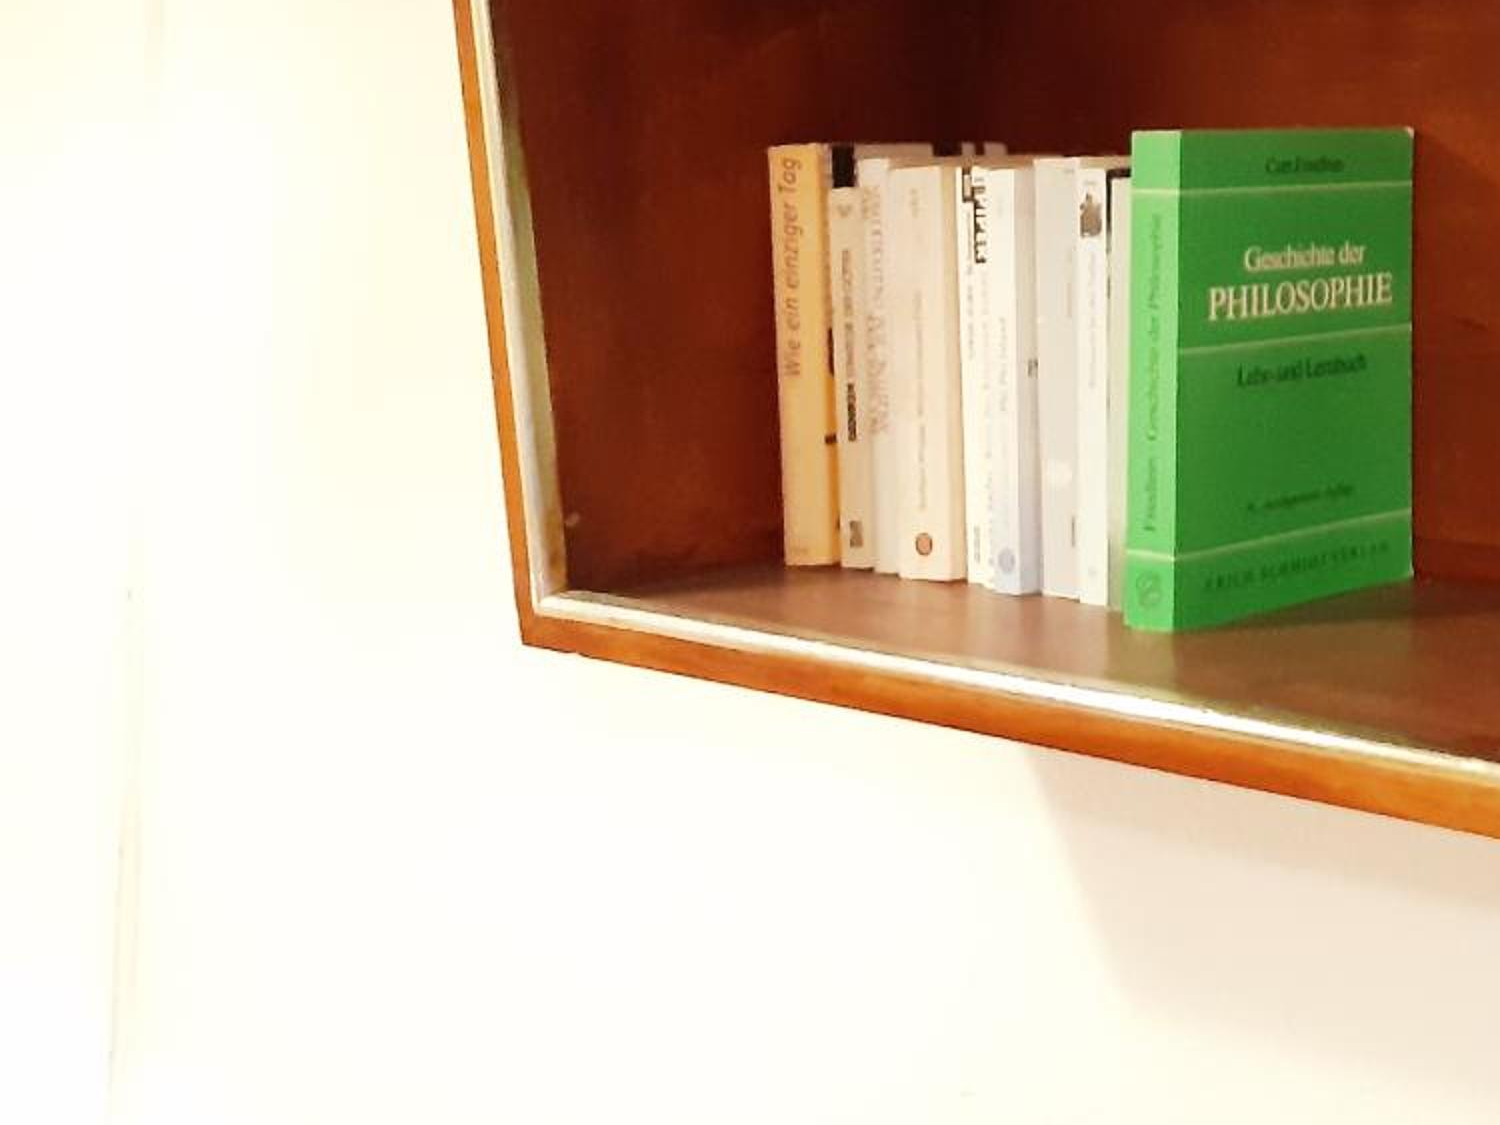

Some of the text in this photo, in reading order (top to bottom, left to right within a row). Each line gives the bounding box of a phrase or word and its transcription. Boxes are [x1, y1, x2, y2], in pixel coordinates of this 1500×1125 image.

[777, 154, 803, 378] Wie ein einziger Tag
[1243, 238, 1366, 272] Geschichte der
[1208, 272, 1394, 322] PHILOSOPHIE
